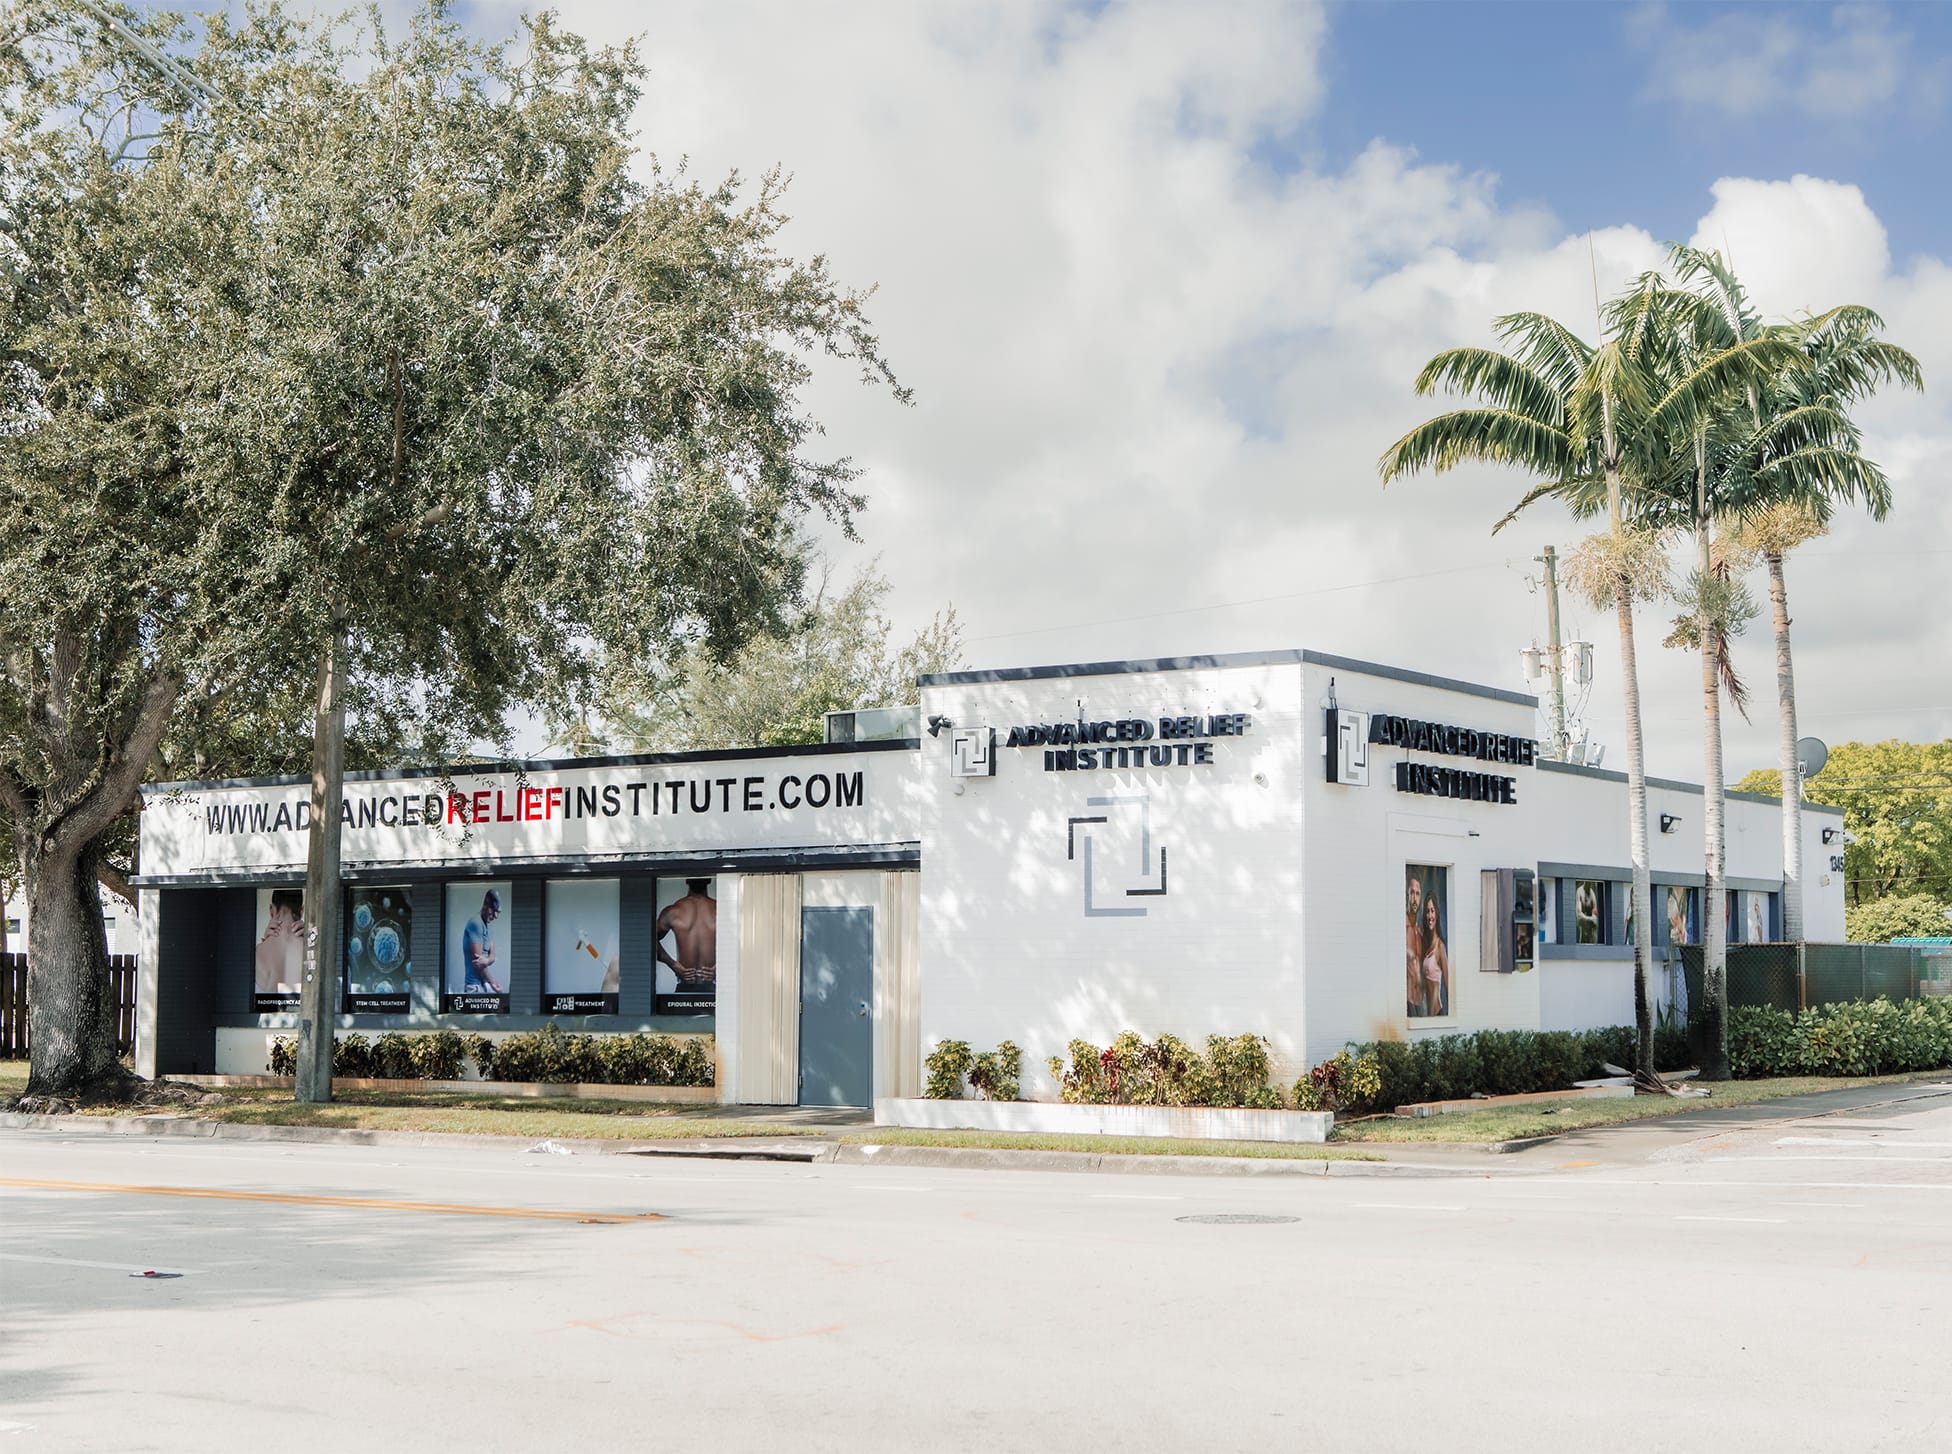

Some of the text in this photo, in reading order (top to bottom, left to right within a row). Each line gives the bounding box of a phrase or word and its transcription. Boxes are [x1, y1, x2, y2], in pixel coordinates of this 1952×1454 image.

[1005, 713, 1251, 748] ADVANCED RELIEF
[1368, 714, 1539, 766] ADVANCED RELIEF
[1044, 742, 1214, 771] INSTITUTE
[206, 771, 864, 834] WWW.ADANCEDRELIEFINSTITUTE.COM
[1396, 762, 1517, 804] INSTITUTE
